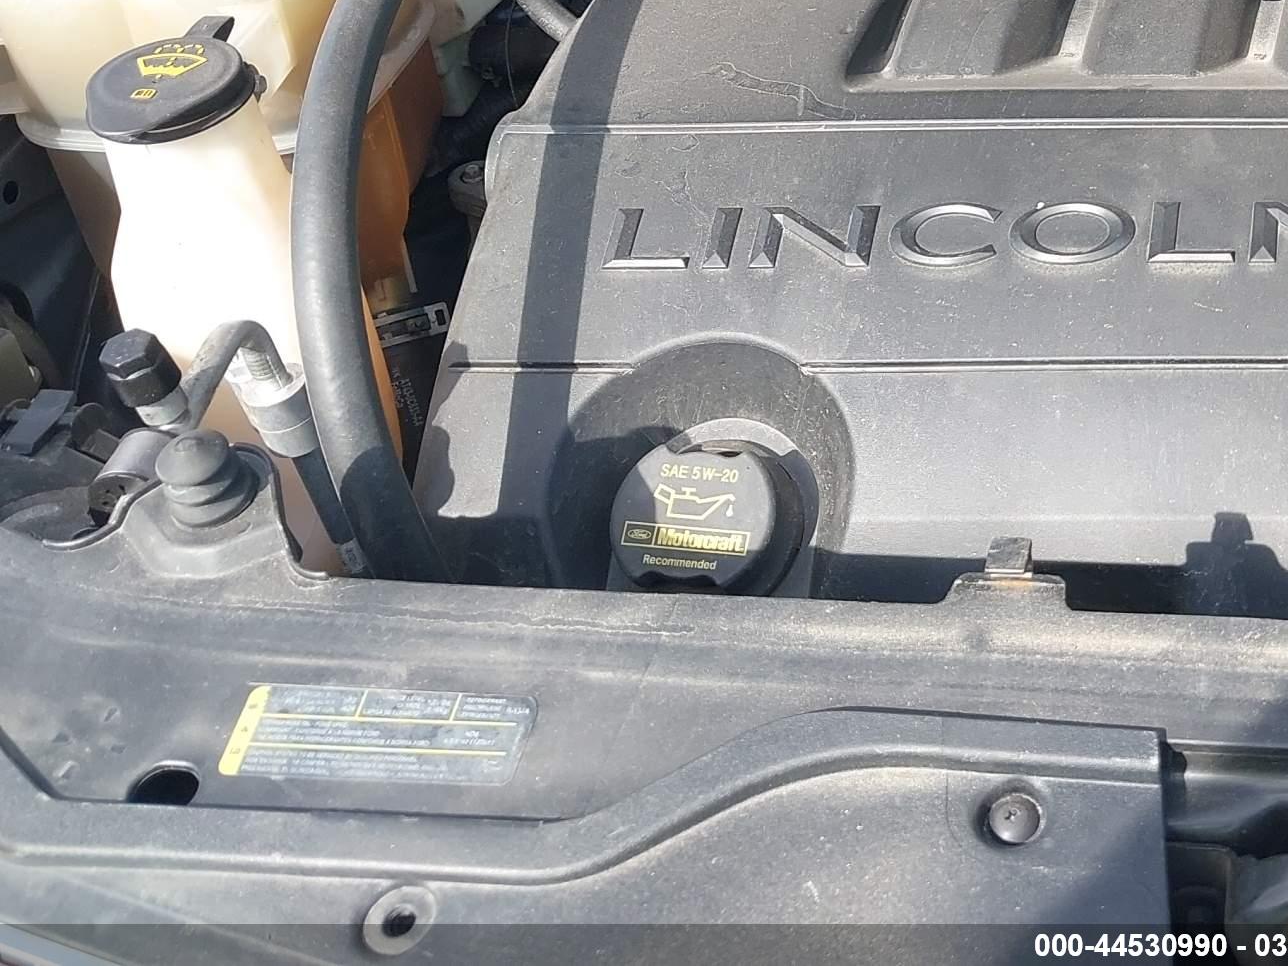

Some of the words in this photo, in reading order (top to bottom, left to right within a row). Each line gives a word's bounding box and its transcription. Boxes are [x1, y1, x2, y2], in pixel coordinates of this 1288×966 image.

[660, 463, 690, 479] SAE
[691, 466, 739, 483] 5W-20
[642, 554, 718, 571] Recommended
